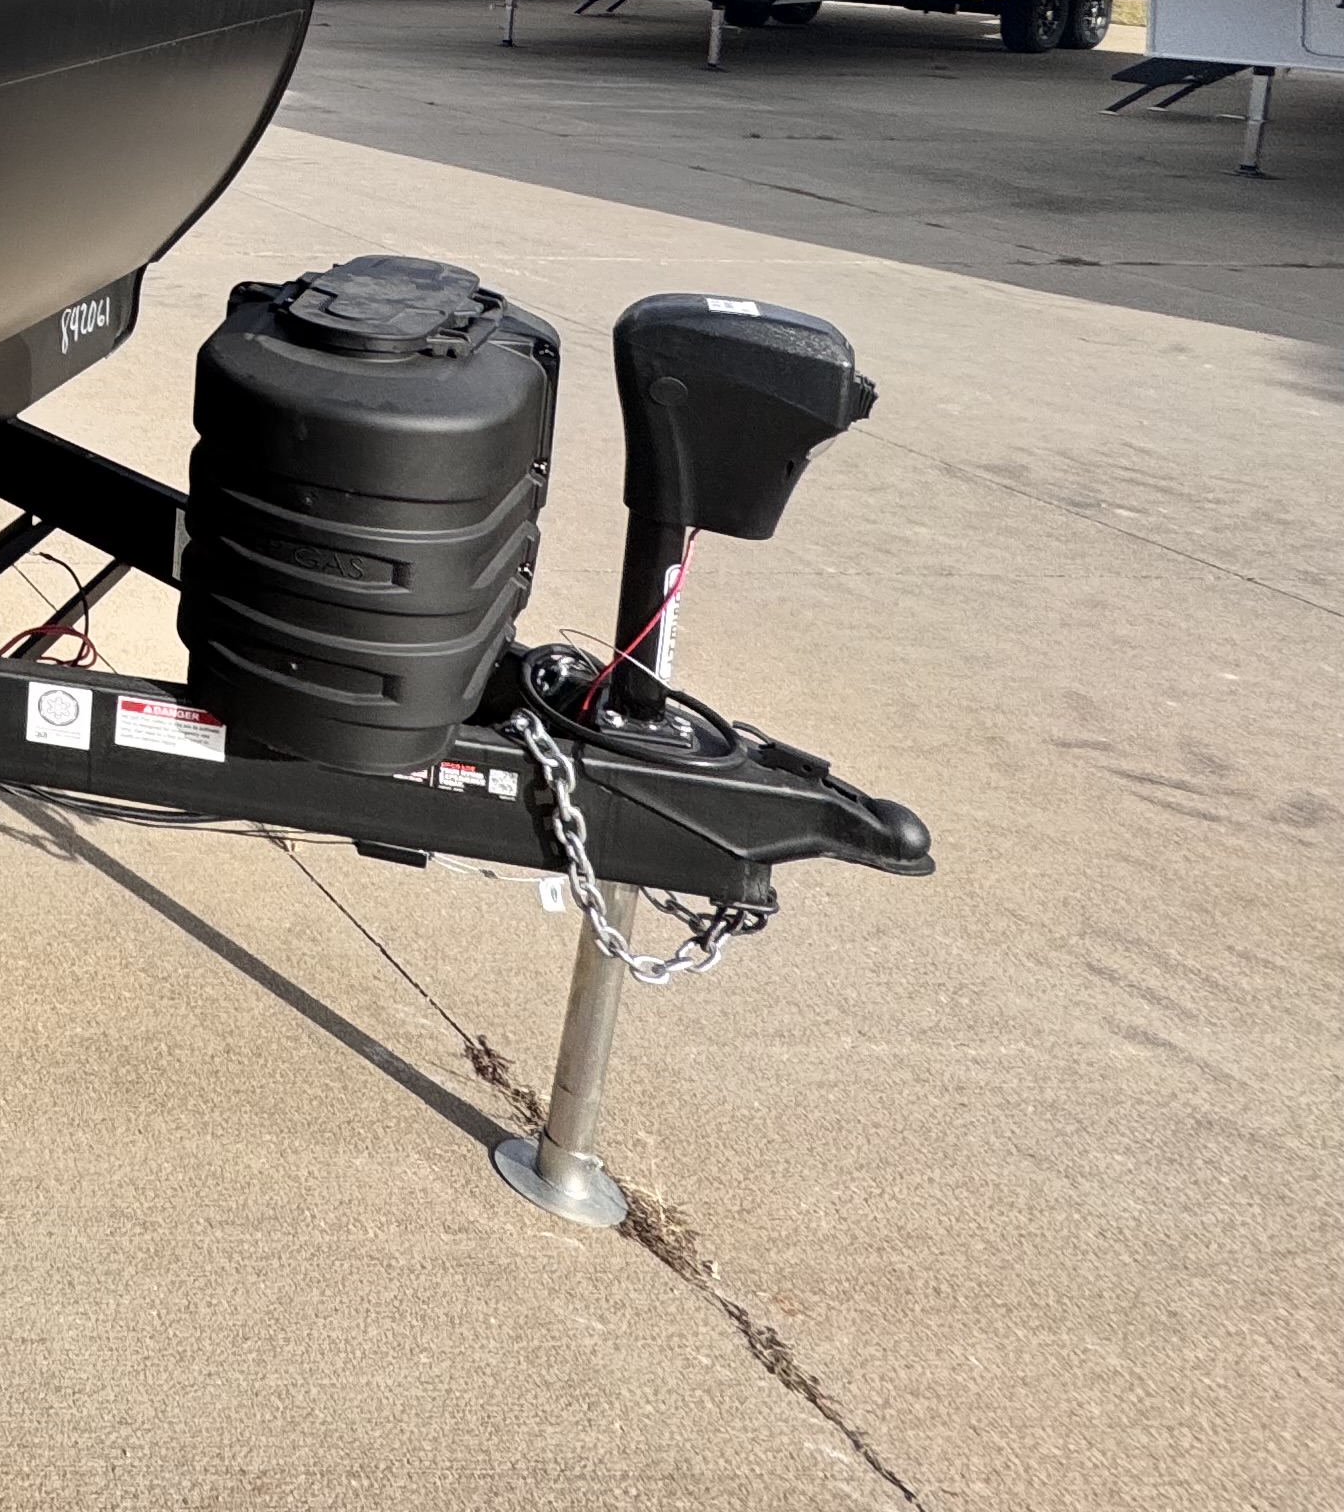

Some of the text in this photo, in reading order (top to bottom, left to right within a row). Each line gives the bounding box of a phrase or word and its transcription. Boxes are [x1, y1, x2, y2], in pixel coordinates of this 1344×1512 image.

[60, 296, 111, 355] 842061
[293, 546, 364, 580] GAS
[153, 705, 200, 722] DANGER
